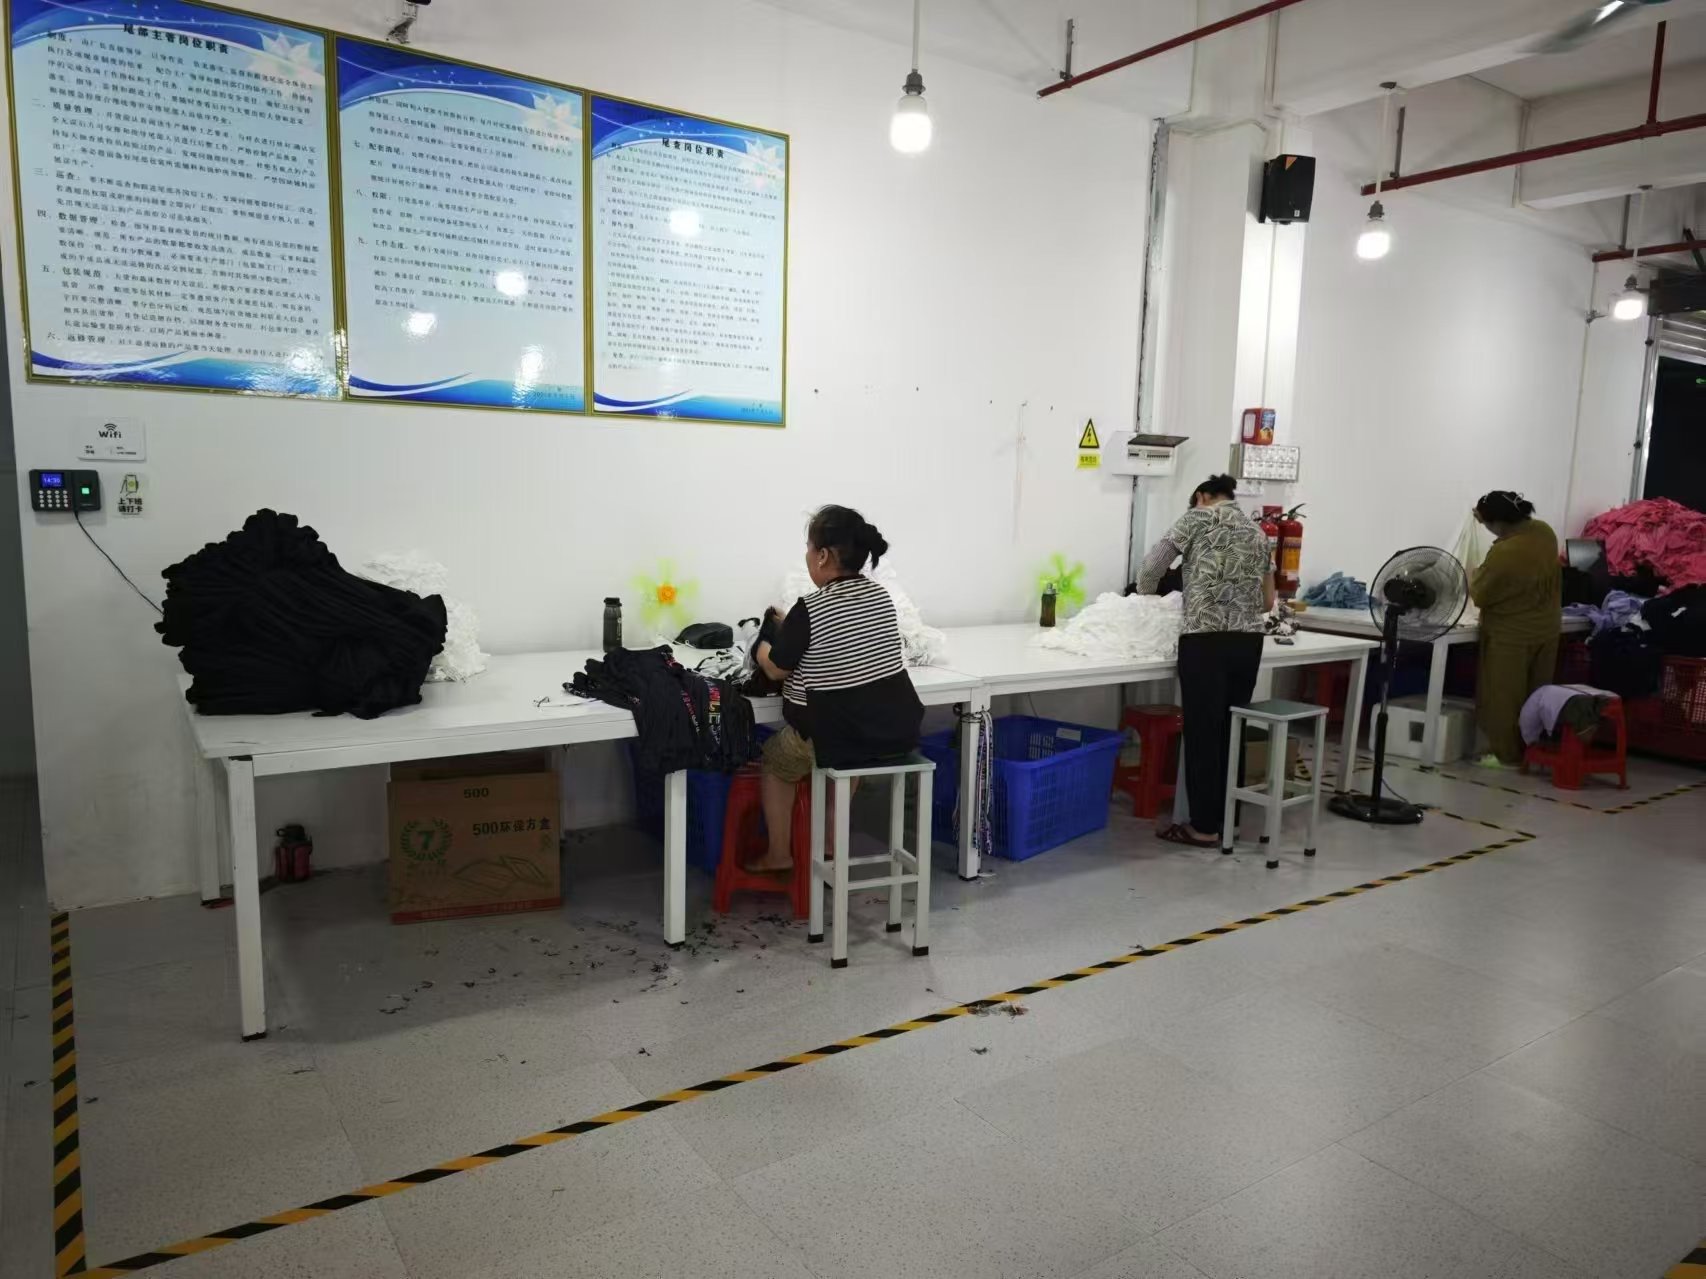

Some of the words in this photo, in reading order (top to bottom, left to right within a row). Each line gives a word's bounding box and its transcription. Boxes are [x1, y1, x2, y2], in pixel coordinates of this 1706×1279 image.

[123, 23, 228, 54] 尾部主管岗位职责
[662, 137, 725, 159] 尾查岗位职责
[98, 430, 122, 438] Wifi
[464, 788, 489, 798] 500
